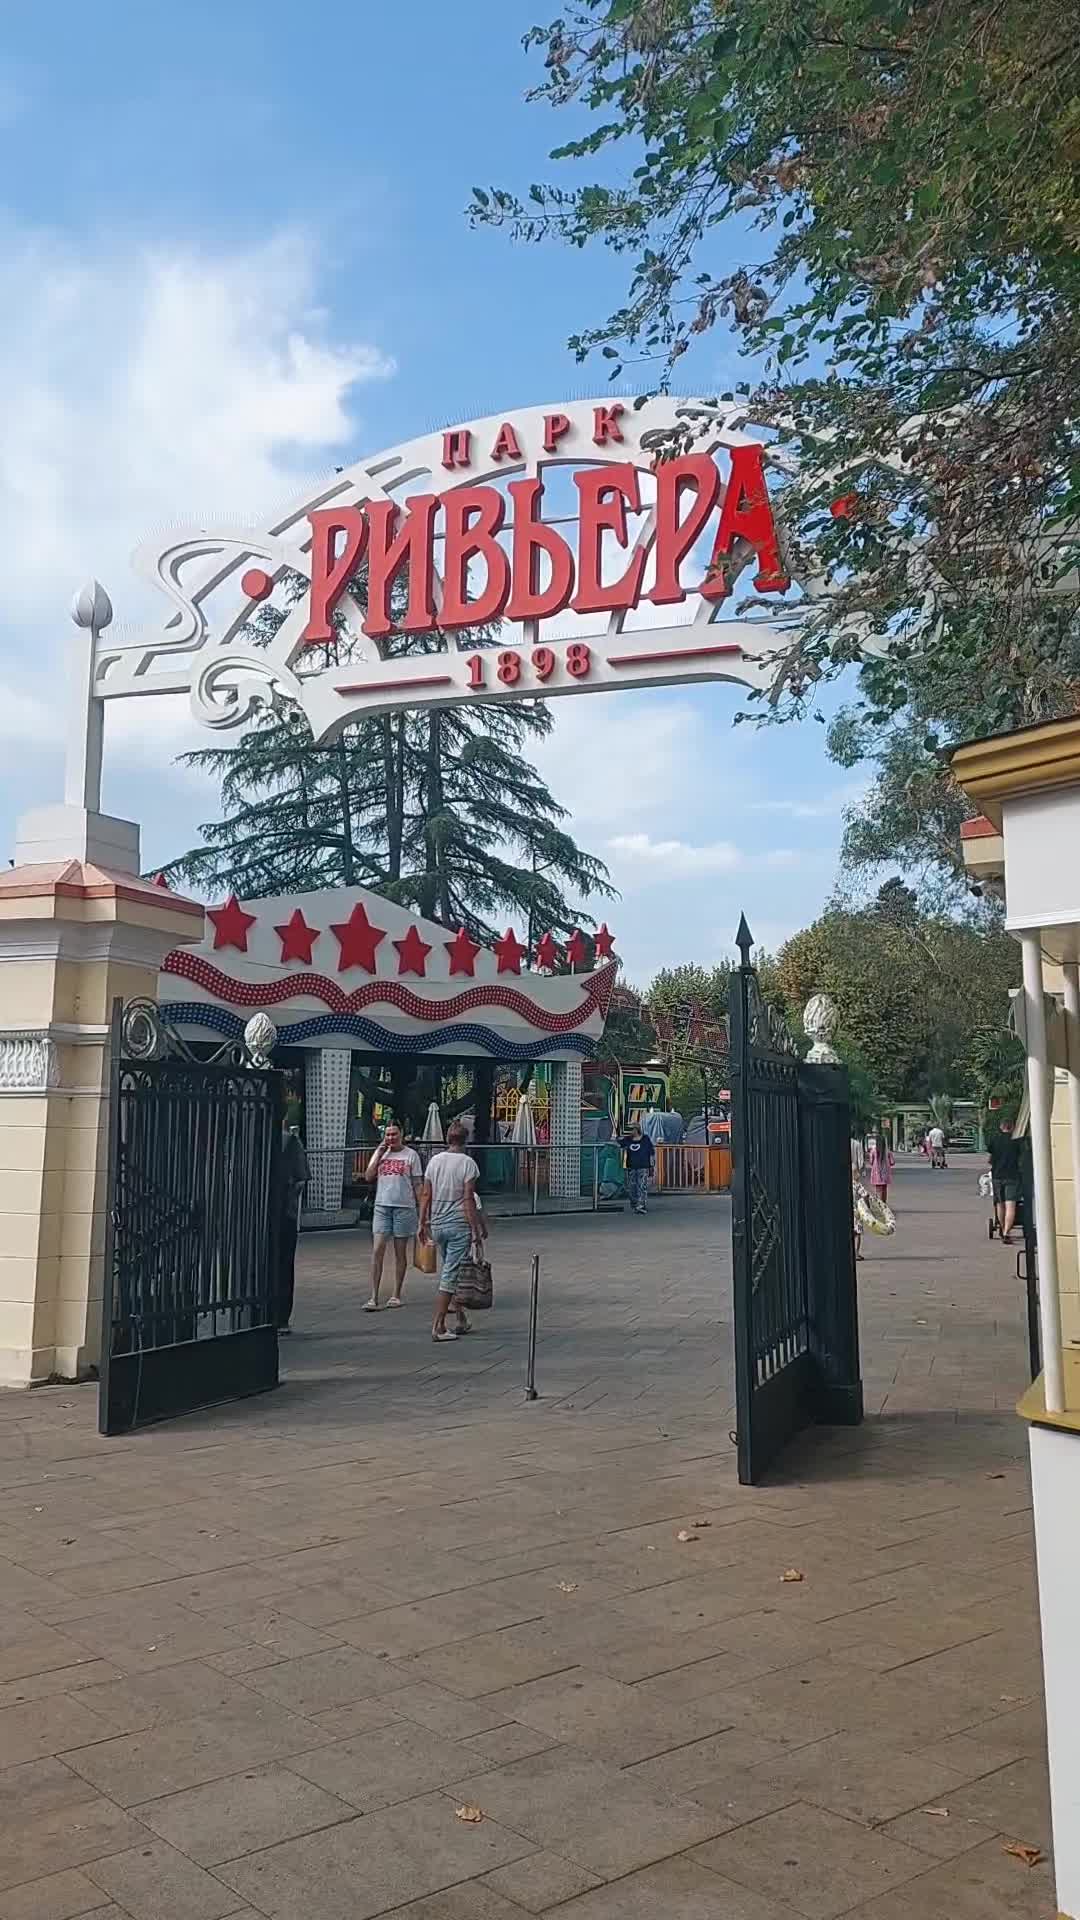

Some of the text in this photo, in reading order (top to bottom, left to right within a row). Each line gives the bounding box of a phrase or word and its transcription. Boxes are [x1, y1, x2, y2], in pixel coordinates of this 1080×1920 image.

[443, 403, 625, 469] ПАРК
[303, 444, 791, 644] РИВЬЕРА
[466, 644, 591, 689] 1898
